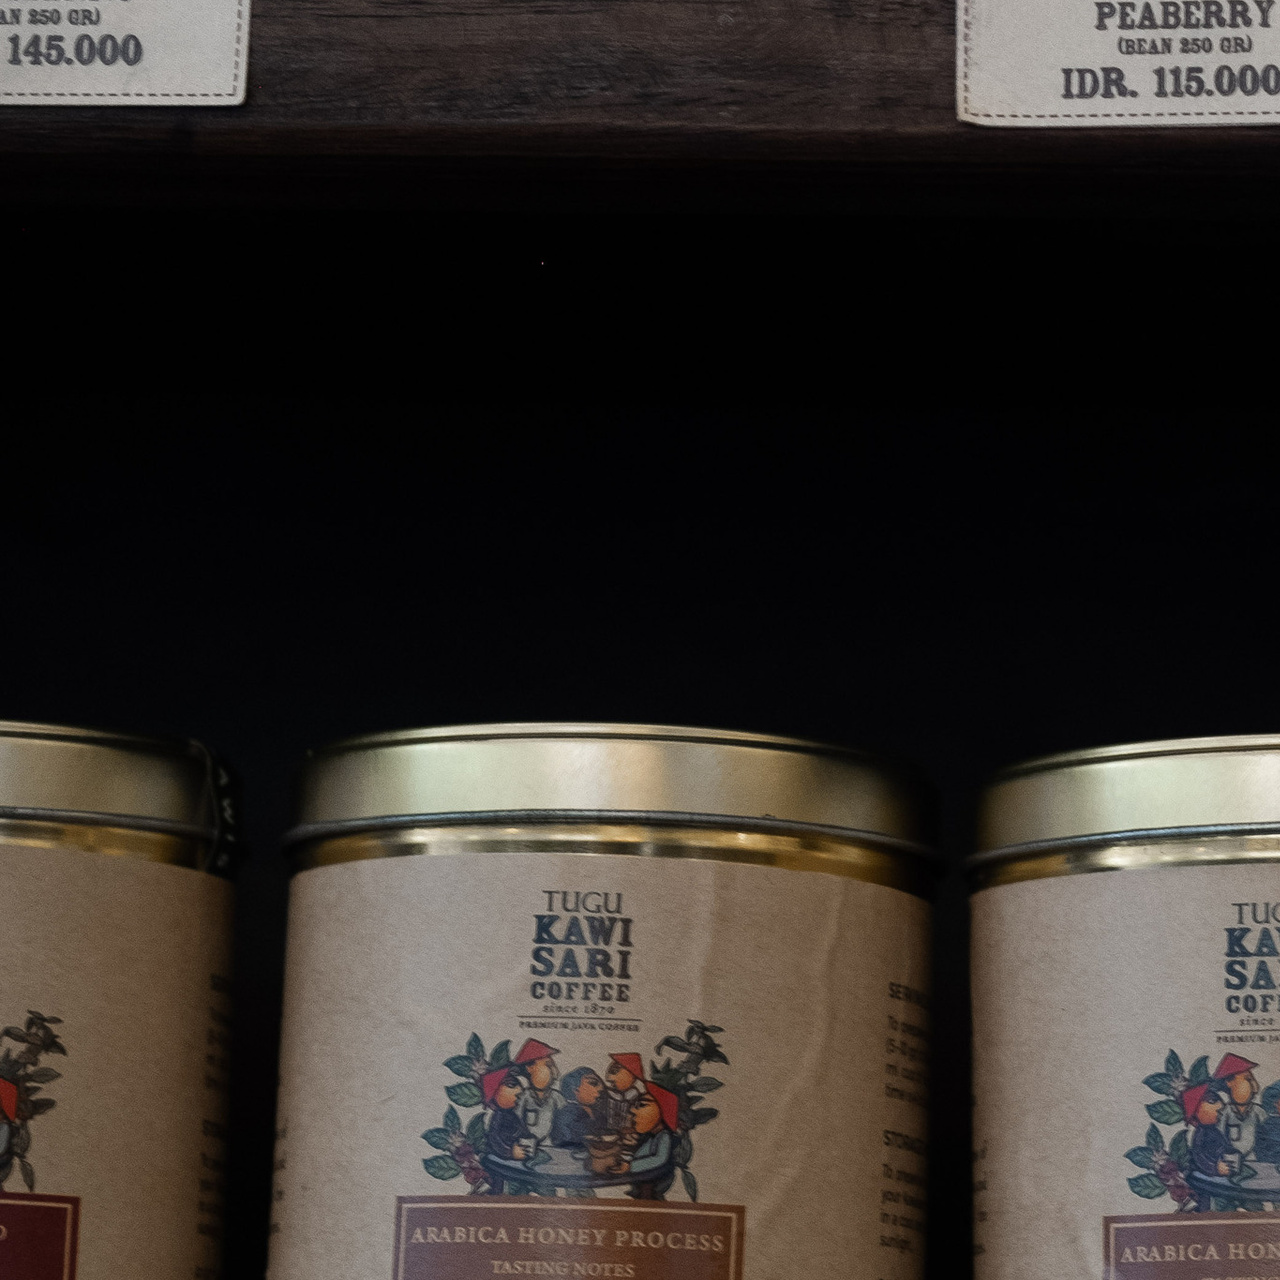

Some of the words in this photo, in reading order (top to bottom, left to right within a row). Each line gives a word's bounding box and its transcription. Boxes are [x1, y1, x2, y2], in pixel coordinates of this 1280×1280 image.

[28, 8, 61, 25] 250
[68, 7, 101, 26] GR)
[1094, 0, 1277, 31] PEABERRY
[8, 33, 143, 66] 145.000
[1118, 36, 1172, 55] (BEAN
[1179, 36, 1212, 54] 250
[1220, 34, 1253, 54] GR)
[1061, 66, 1138, 99] IDR.
[542, 890, 622, 914] TUGU
[533, 914, 634, 947] KAWI
[530, 946, 631, 979] SARI
[531, 981, 630, 1001] COFFEE
[411, 1226, 511, 1244] ARABICA
[518, 1228, 606, 1246] HONEY
[615, 1231, 724, 1252] PROCESS
[1120, 1244, 1220, 1263] ARABICA
[491, 1260, 570, 1276] TASTING
[573, 1262, 635, 1278] NOTES
